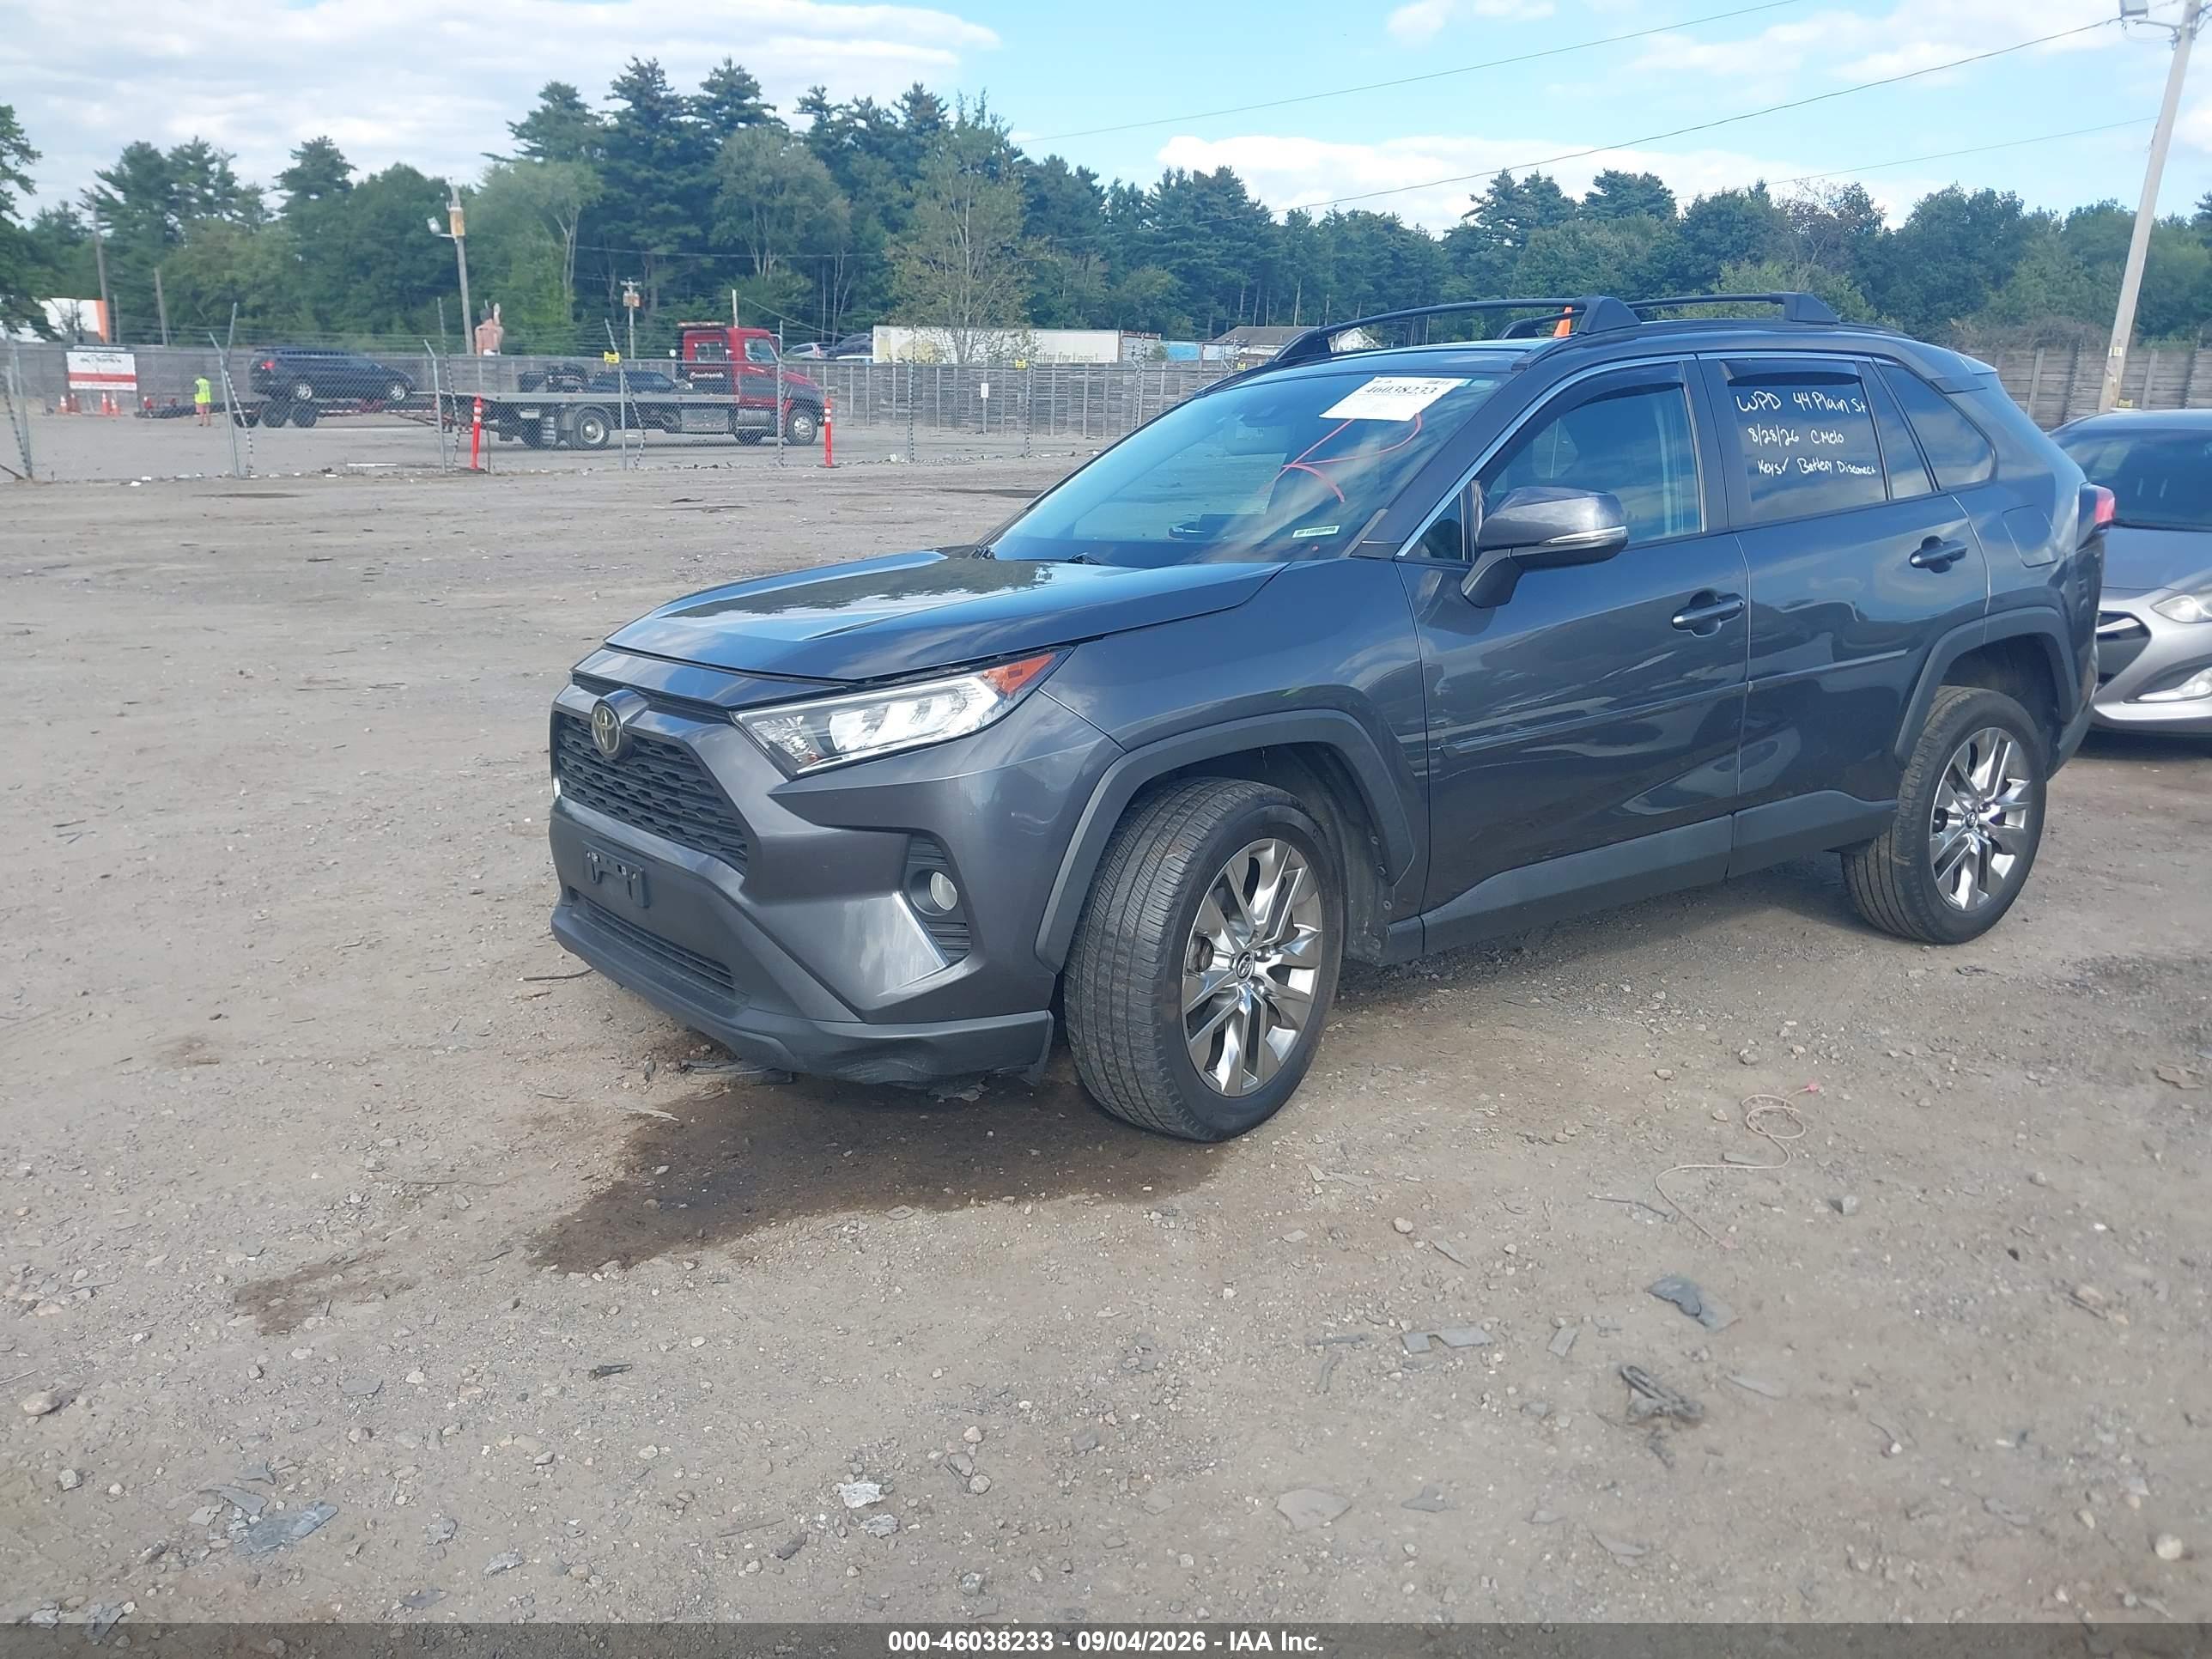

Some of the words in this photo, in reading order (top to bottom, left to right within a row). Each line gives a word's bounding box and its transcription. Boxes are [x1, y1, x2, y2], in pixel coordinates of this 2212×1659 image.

[1364, 385, 1438, 395] 46038233
[1736, 391, 1782, 411] WPD
[1792, 392, 1812, 411] 44
[1812, 392, 1850, 414] Plain
[1850, 398, 1867, 413] St
[1747, 423, 1800, 447] 8/28/26
[1796, 457, 1832, 474] Battery
